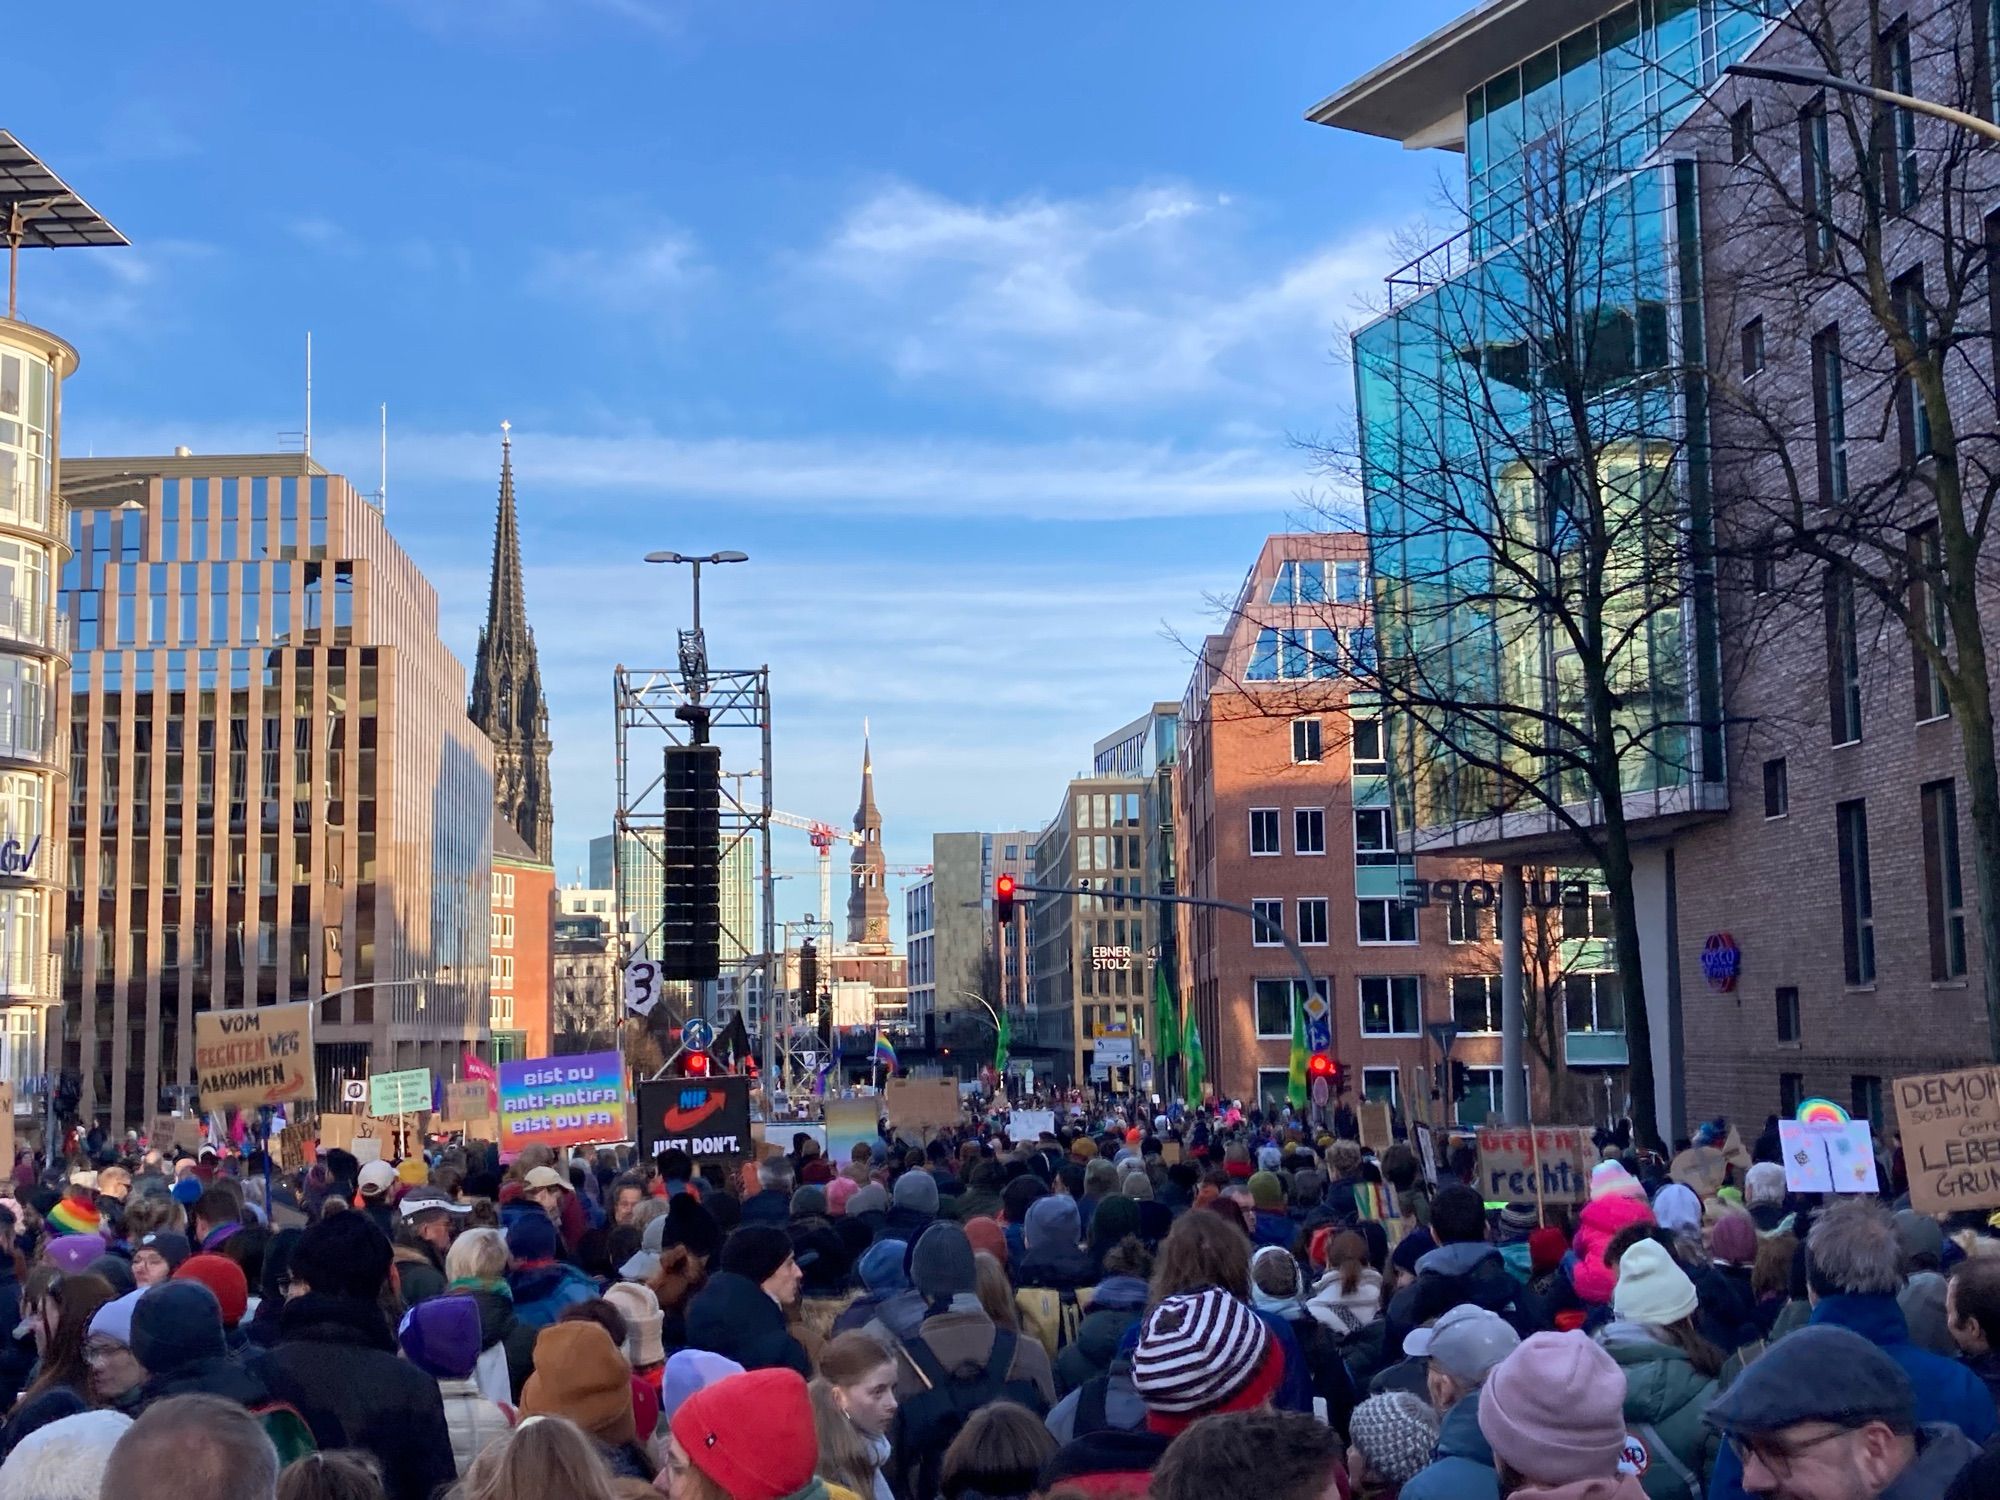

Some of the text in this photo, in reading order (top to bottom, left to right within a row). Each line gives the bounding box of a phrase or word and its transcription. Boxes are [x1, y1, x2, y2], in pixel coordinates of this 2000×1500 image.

[1092, 946, 1131, 958] EBNER
[1093, 958, 1131, 970] STOLZ
[632, 963, 655, 1005] 3
[220, 1014, 260, 1034] VOM
[268, 1031, 299, 1057] WEG
[806, 1053, 815, 1067] 2
[200, 1063, 285, 1094] ABKOMMEN
[587, 1112, 611, 1126] FA
